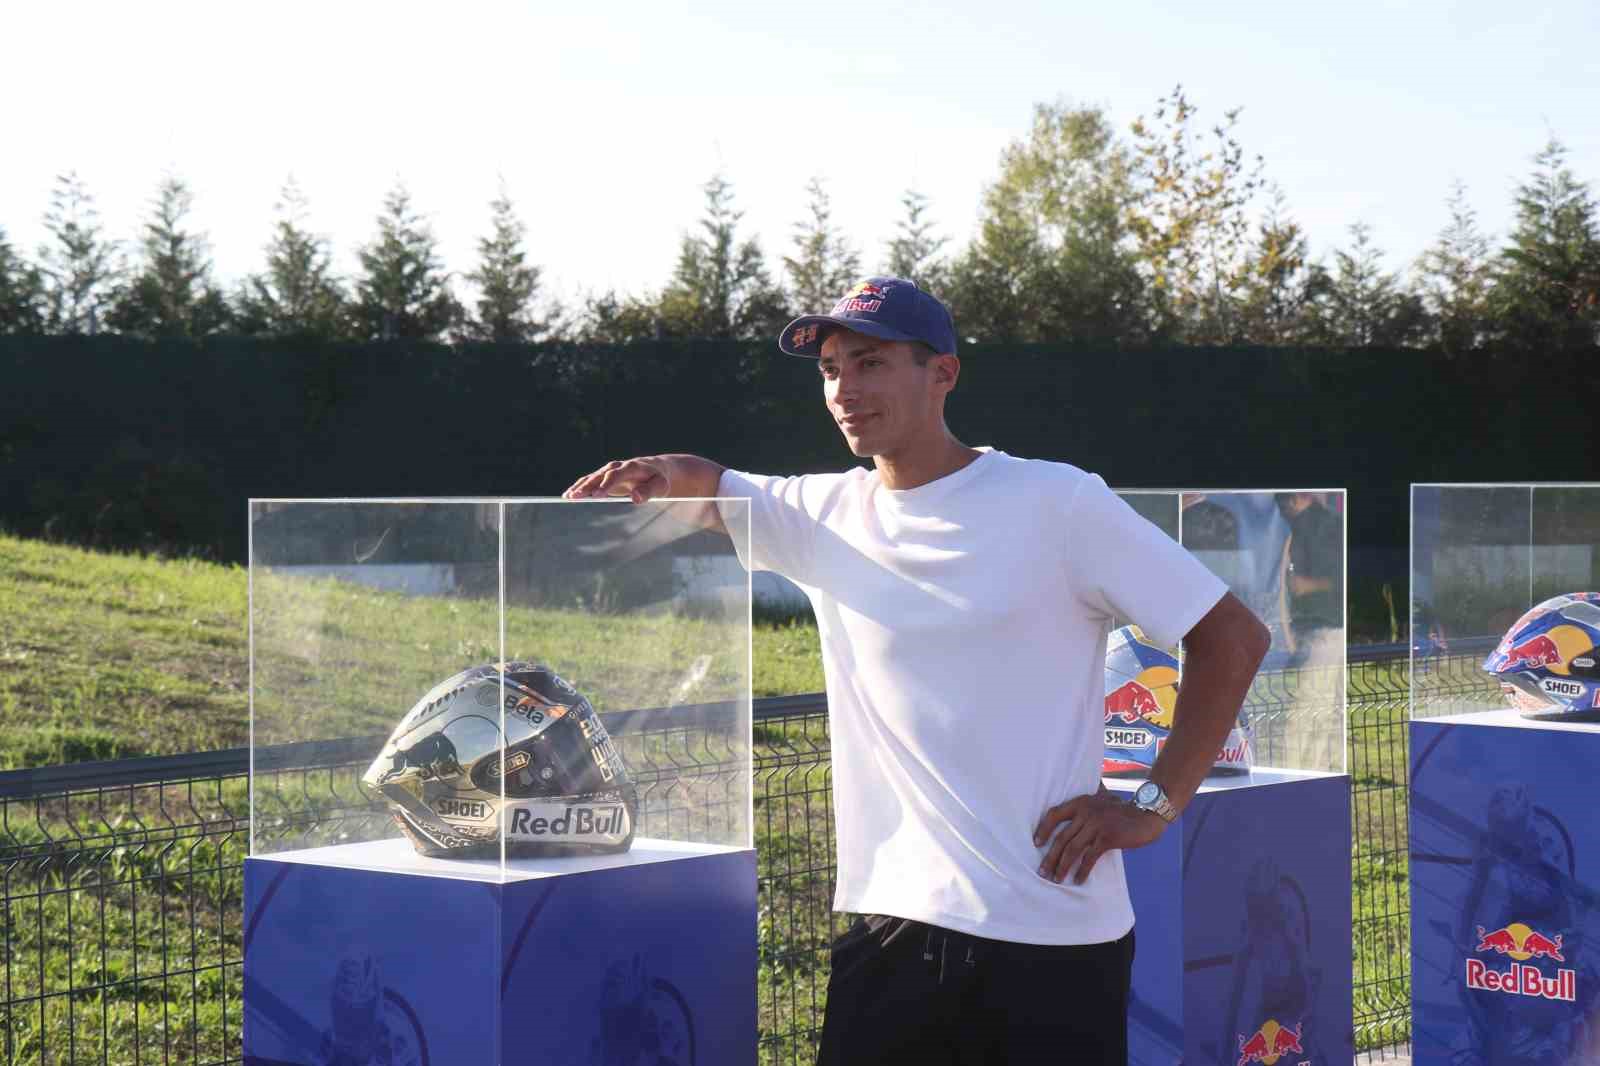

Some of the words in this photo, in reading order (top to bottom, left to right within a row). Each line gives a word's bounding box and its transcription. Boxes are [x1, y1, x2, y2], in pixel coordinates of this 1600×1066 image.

[1544, 681, 1580, 695] SHOEI
[504, 694, 545, 724] Beta
[1105, 731, 1146, 744] SHOEI
[438, 800, 485, 818] SHOEI
[511, 807, 572, 835] Red
[575, 807, 624, 835] Bull
[1466, 958, 1520, 993] Red
[1521, 965, 1576, 1001] Bull
